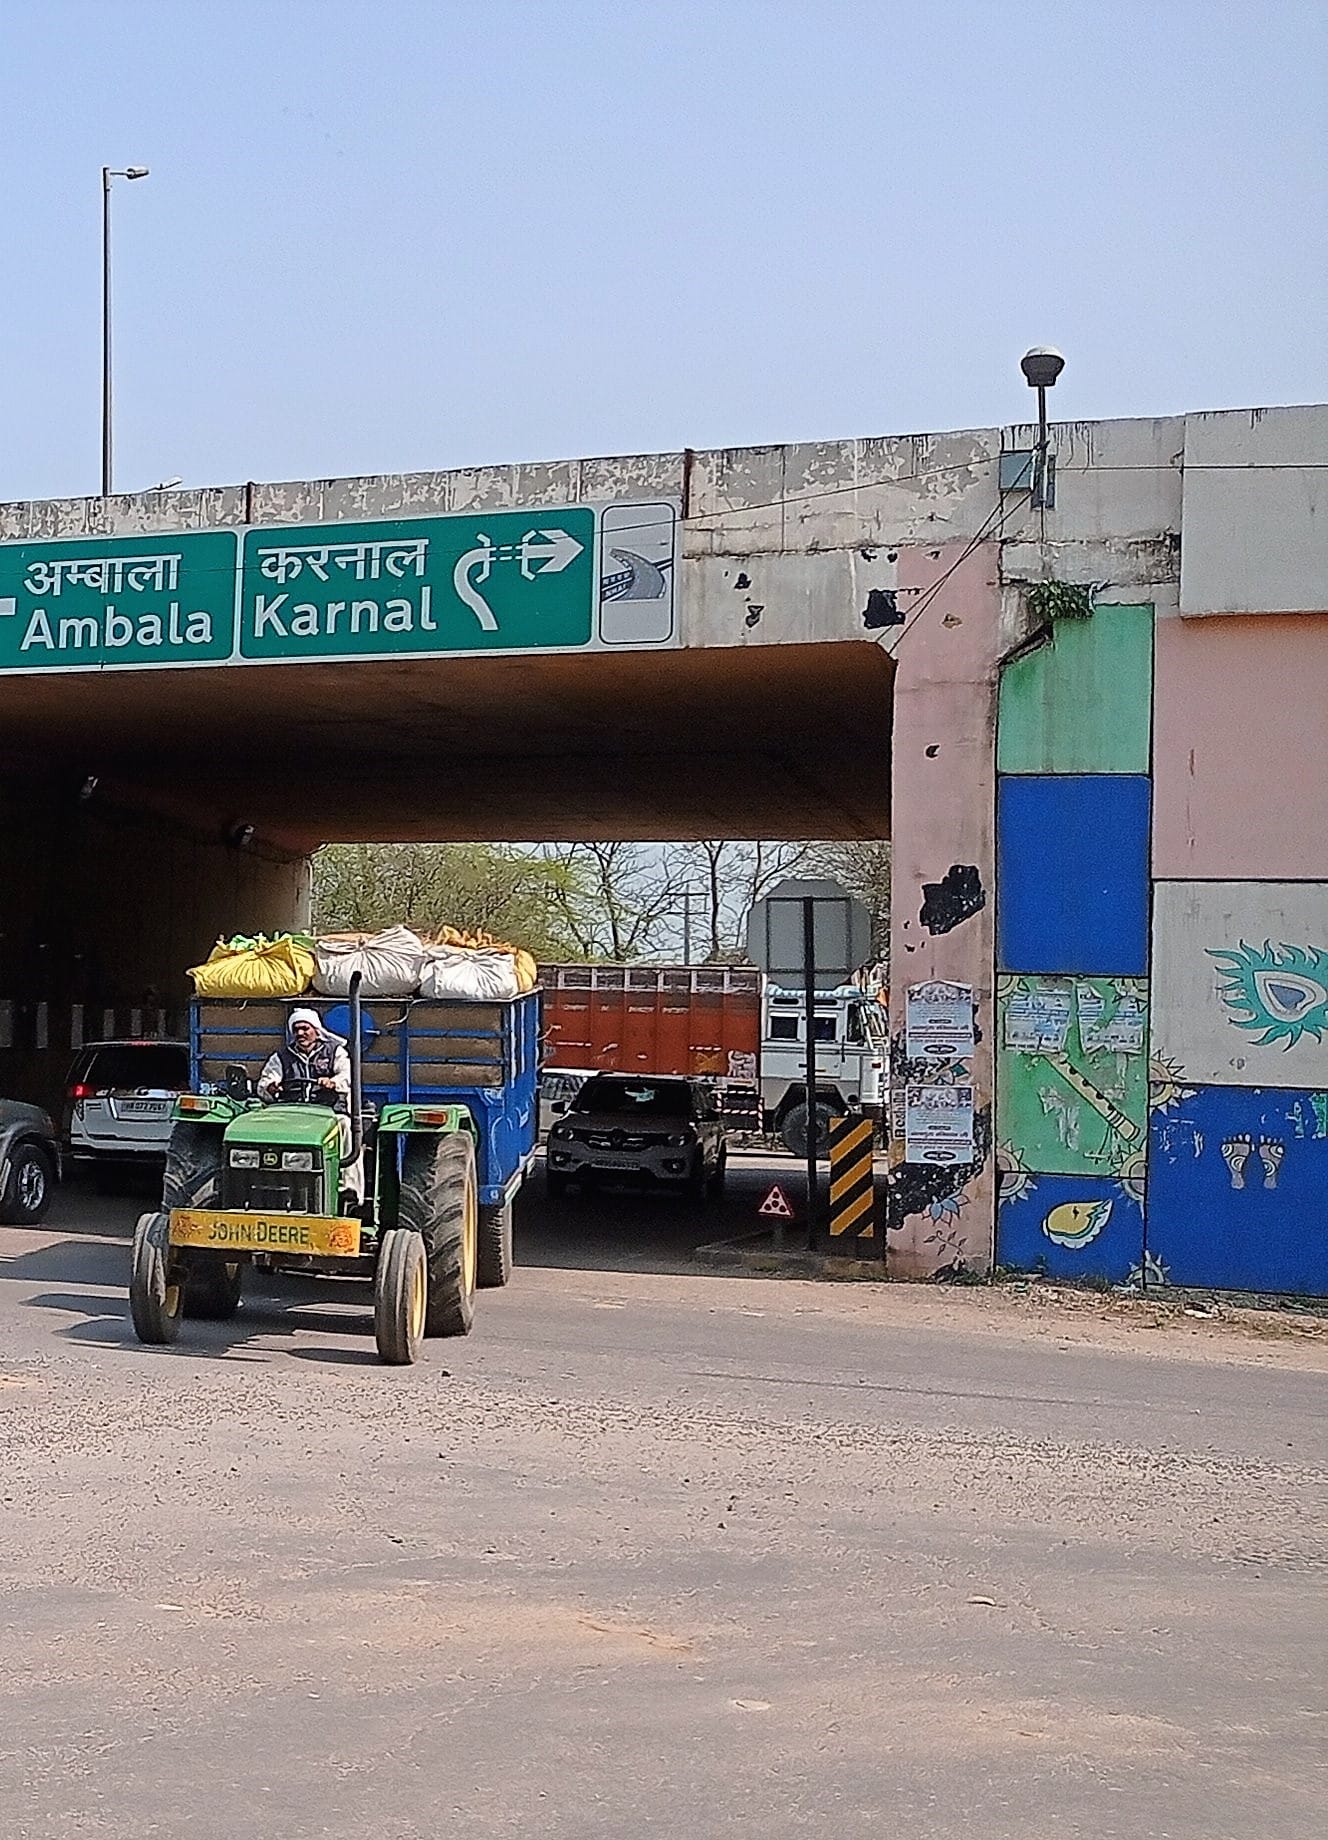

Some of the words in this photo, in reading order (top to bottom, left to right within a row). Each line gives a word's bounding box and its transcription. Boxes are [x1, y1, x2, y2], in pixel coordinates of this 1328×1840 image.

[23, 553, 182, 596] अम्बाला
[257, 538, 430, 584] करनाल
[20, 601, 214, 651] Ambala
[253, 585, 437, 638] Karnal
[208, 1222, 251, 1242] JOHN
[256, 1221, 310, 1245] DEERE
